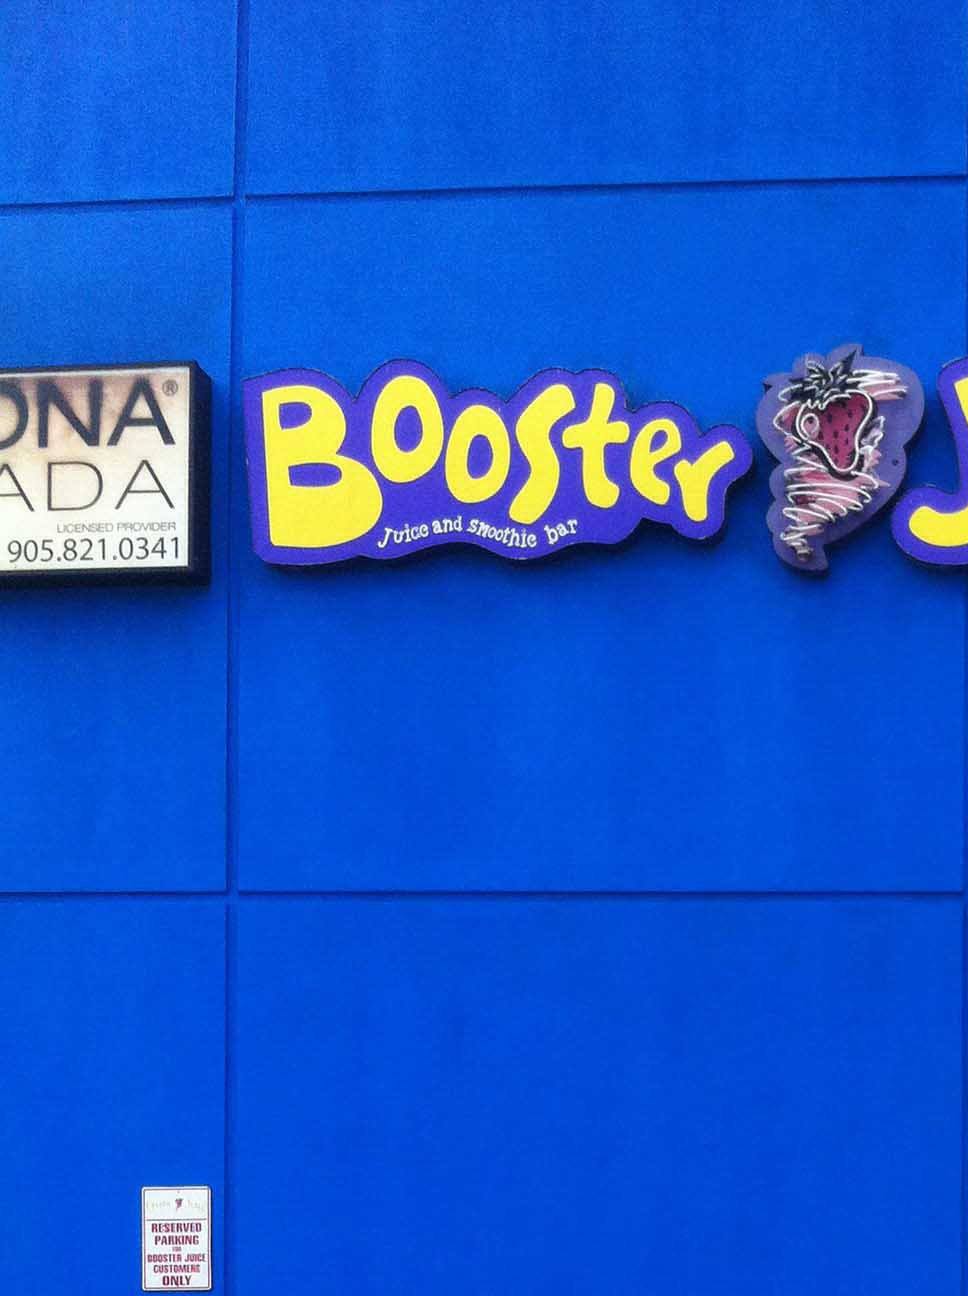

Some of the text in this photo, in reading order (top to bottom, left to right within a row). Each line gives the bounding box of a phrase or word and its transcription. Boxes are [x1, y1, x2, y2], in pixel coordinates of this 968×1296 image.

[262, 375, 734, 548] Booster
[57, 522, 176, 533] LICENSED PROVIDER
[377, 516, 578, 548] Juice and smoothie bar
[7, 537, 179, 563] 905.821.0341
[151, 1223, 202, 1233] RESERVED
[154, 1235, 199, 1245] PARKING
[147, 1253, 206, 1263] BOOSTER JUICE
[153, 1264, 201, 1273] CUSTOMERS
[162, 1275, 192, 1286] ONLY
